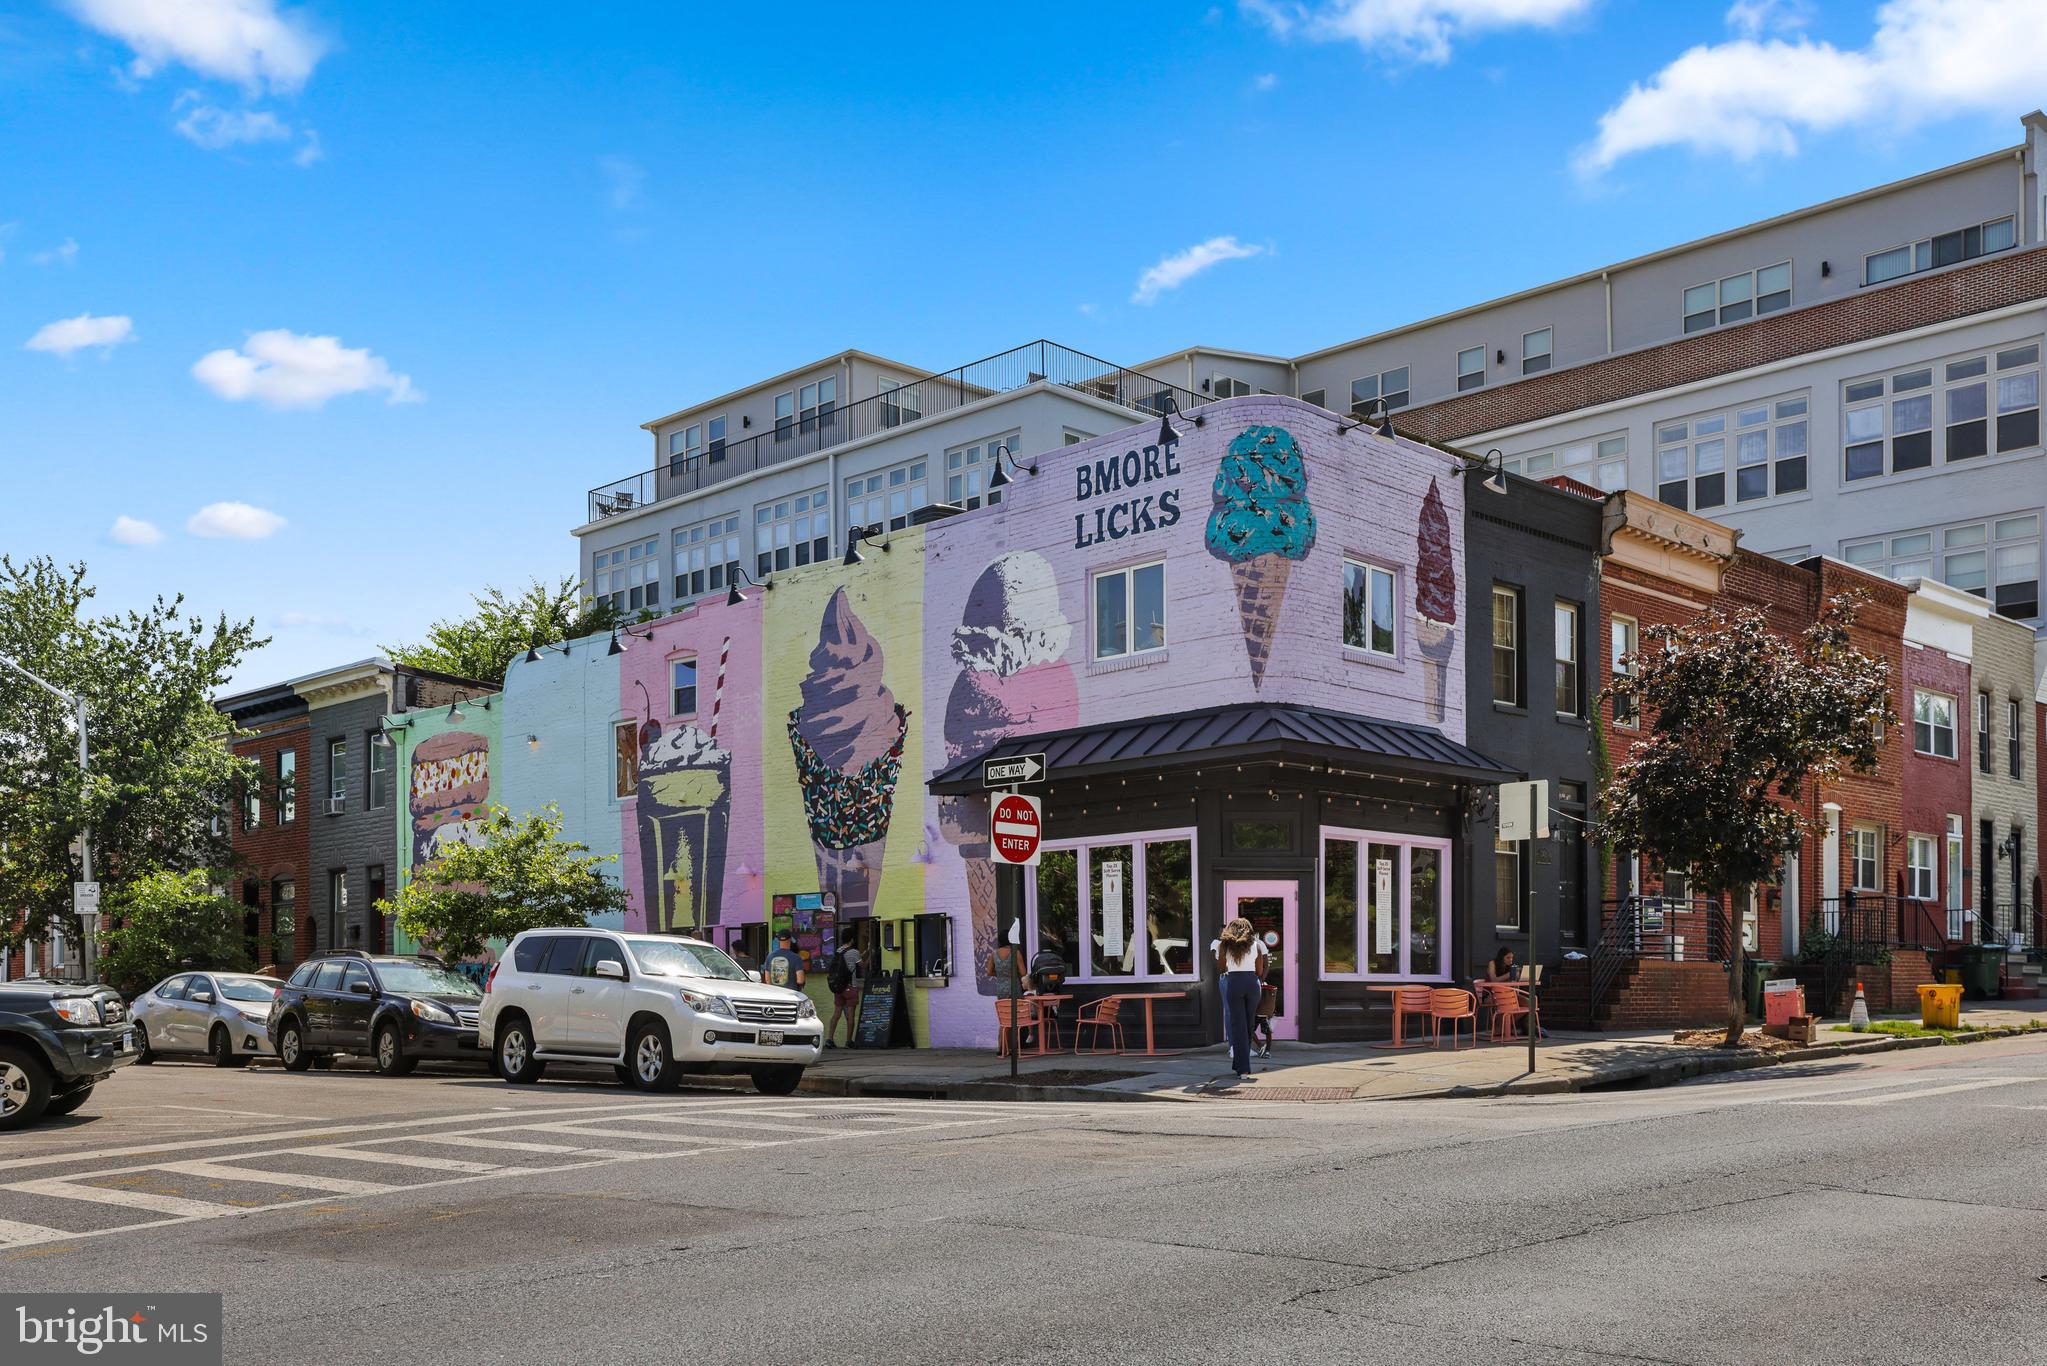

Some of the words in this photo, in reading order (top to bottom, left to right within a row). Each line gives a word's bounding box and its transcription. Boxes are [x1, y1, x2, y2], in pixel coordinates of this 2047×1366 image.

[1076, 439, 1180, 501] BMORE
[1075, 489, 1180, 549] LICKS
[990, 767, 1005, 778] ONE
[1009, 764, 1025, 776] WAY
[1000, 808, 1012, 819] DO
[1016, 810, 1033, 821] NOT
[1002, 838, 1030, 850] ENTER
